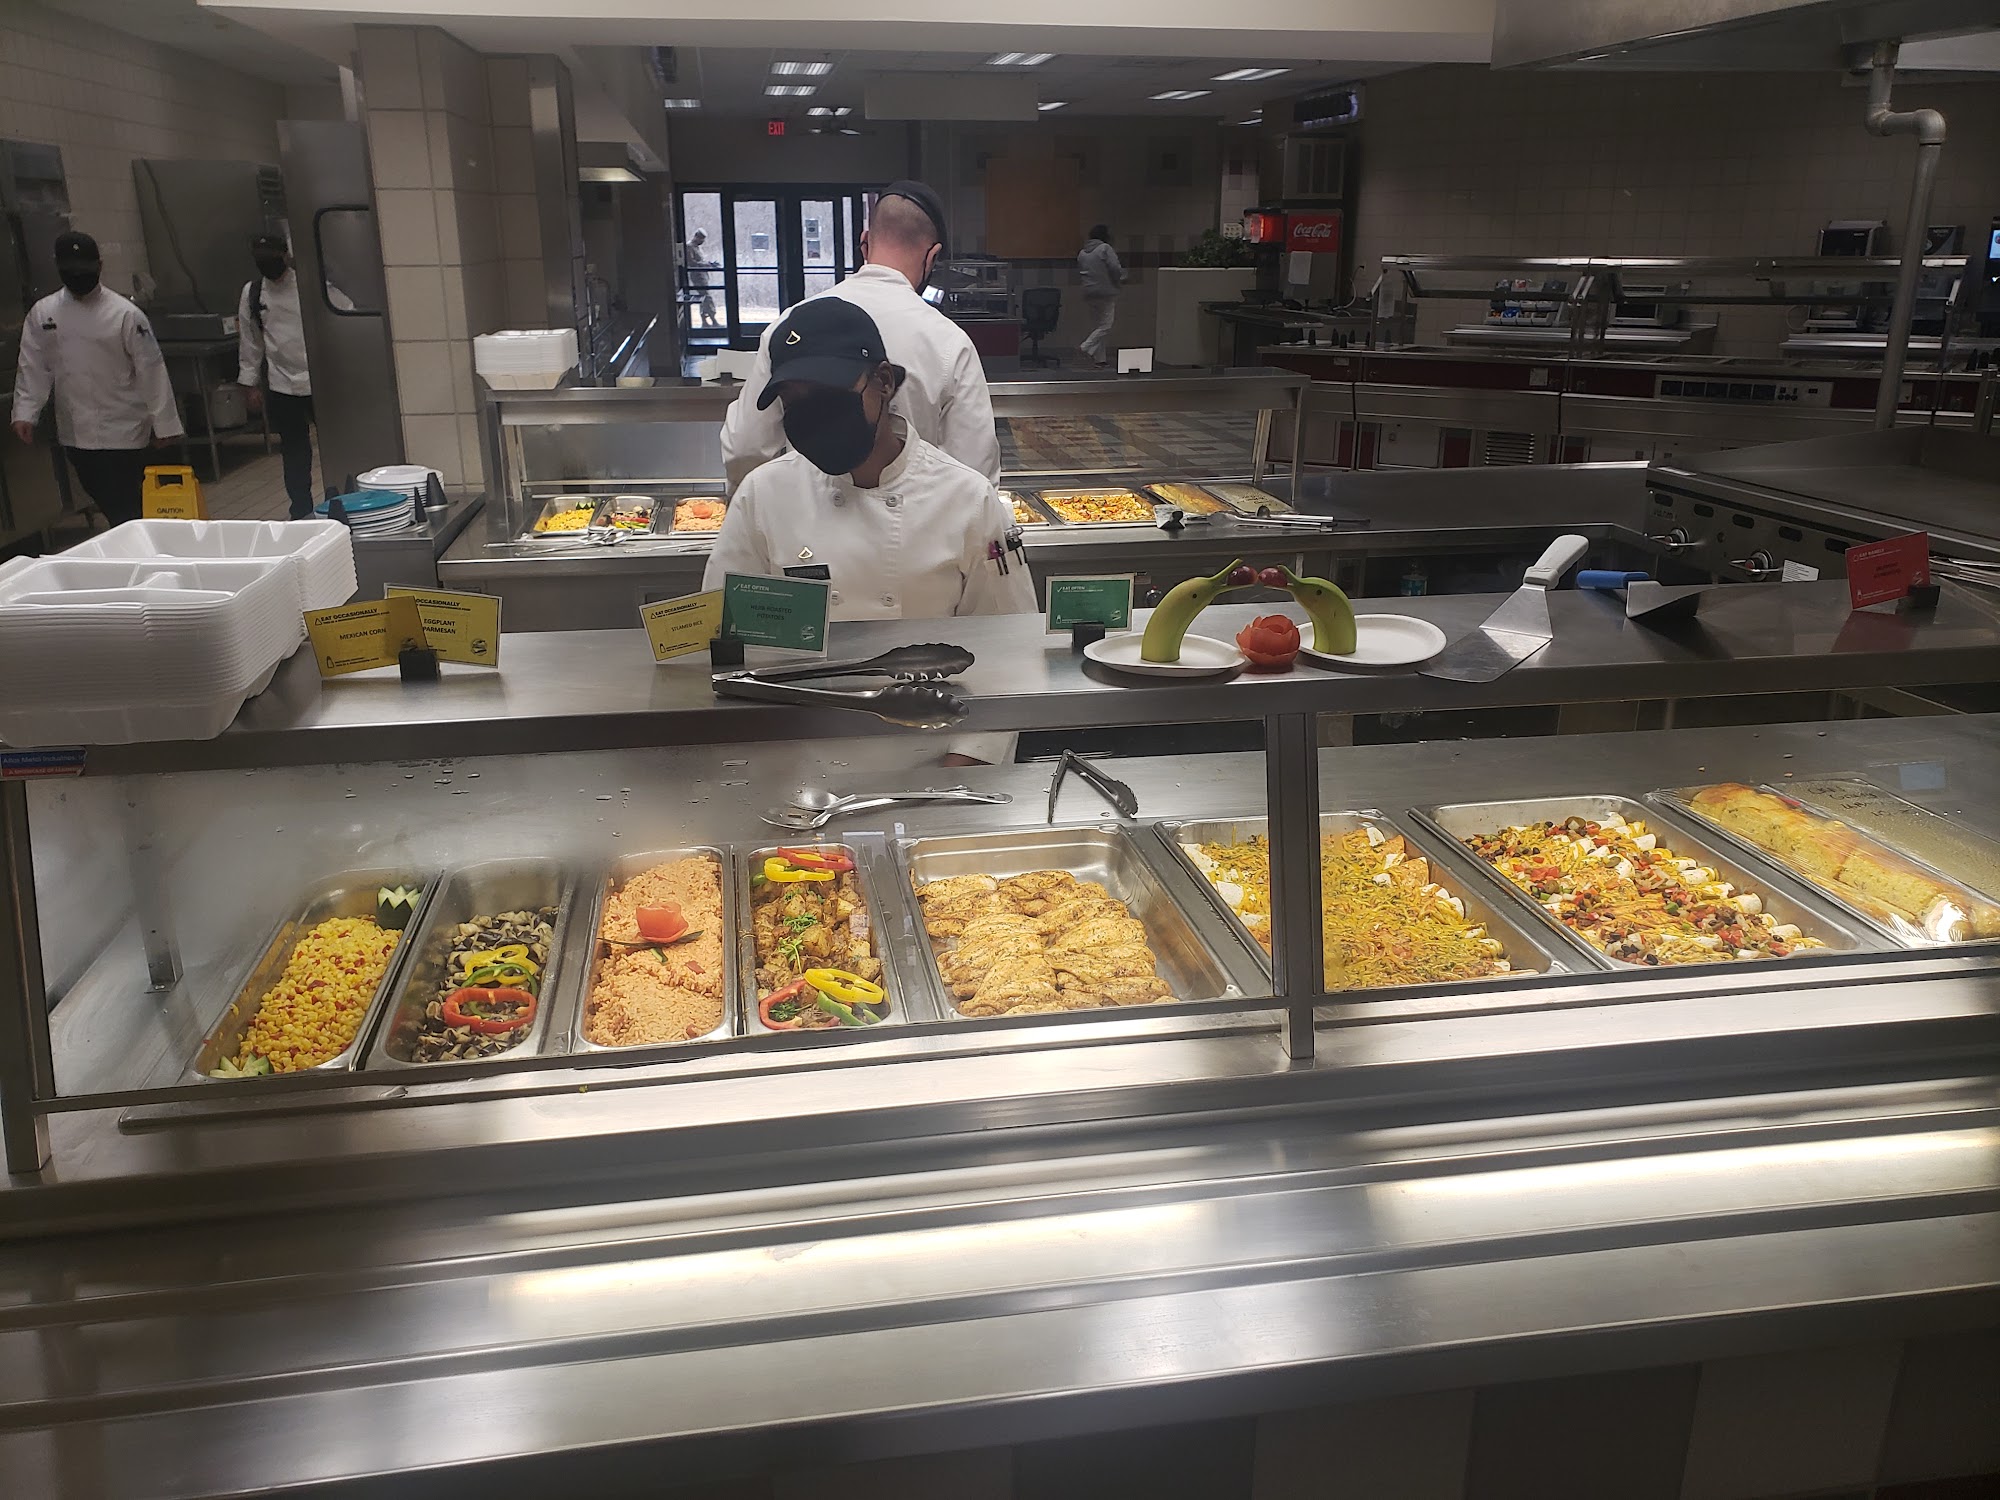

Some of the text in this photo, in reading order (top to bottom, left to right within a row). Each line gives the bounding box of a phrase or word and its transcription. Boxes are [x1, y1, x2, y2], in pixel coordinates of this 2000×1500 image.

[768, 121, 785, 136] EXIT
[751, 584, 770, 592] OFTEN
[415, 598, 461, 608] OCCASIONALLY
[320, 614, 333, 622] EAT
[333, 607, 378, 620] OCCASIONALLY
[756, 613, 785, 621] POTATOES
[423, 618, 456, 627] EGGPLANT
[693, 619, 703, 628] RICE
[339, 627, 387, 641] MEXICAN CORN
[422, 626, 456, 635] PARMESAN
